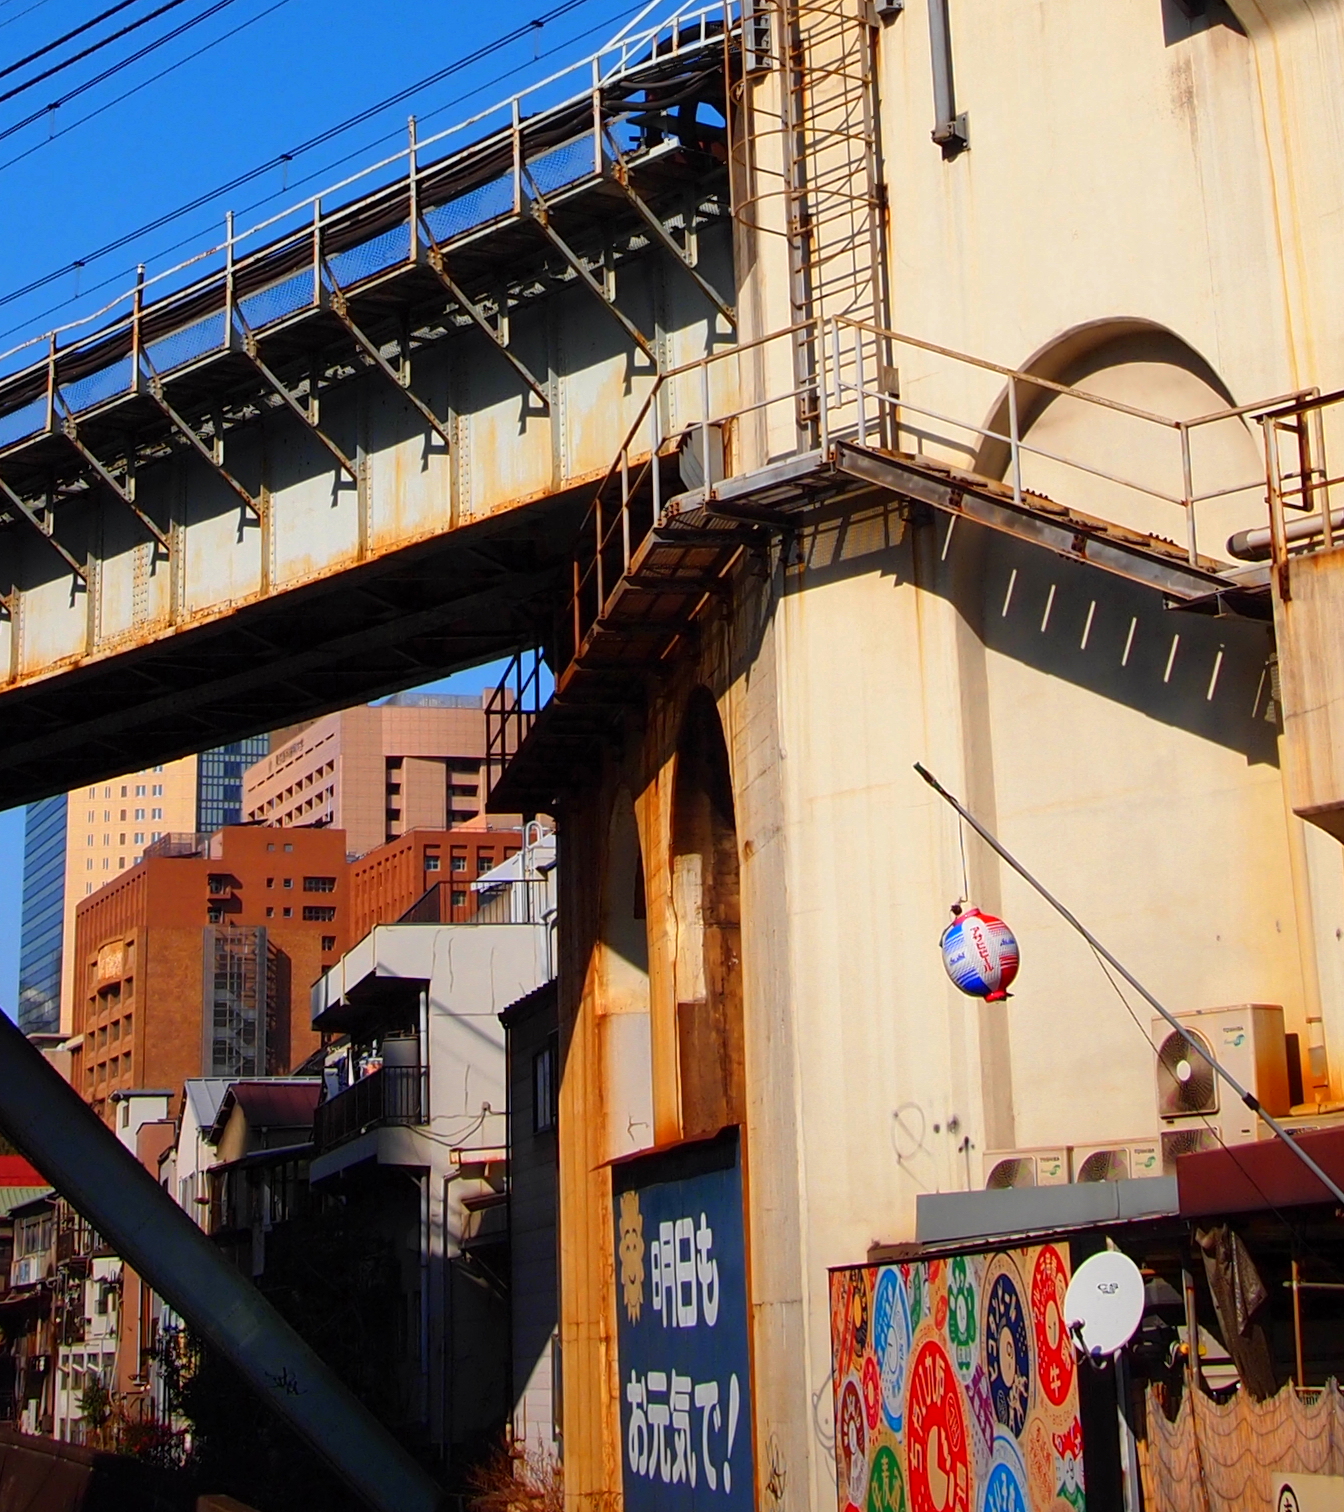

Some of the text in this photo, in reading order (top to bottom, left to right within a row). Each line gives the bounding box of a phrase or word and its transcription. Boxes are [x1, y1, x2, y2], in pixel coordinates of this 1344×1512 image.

[650, 1211, 719, 1327] 明日も
[626, 1367, 740, 1495] お元気で!
